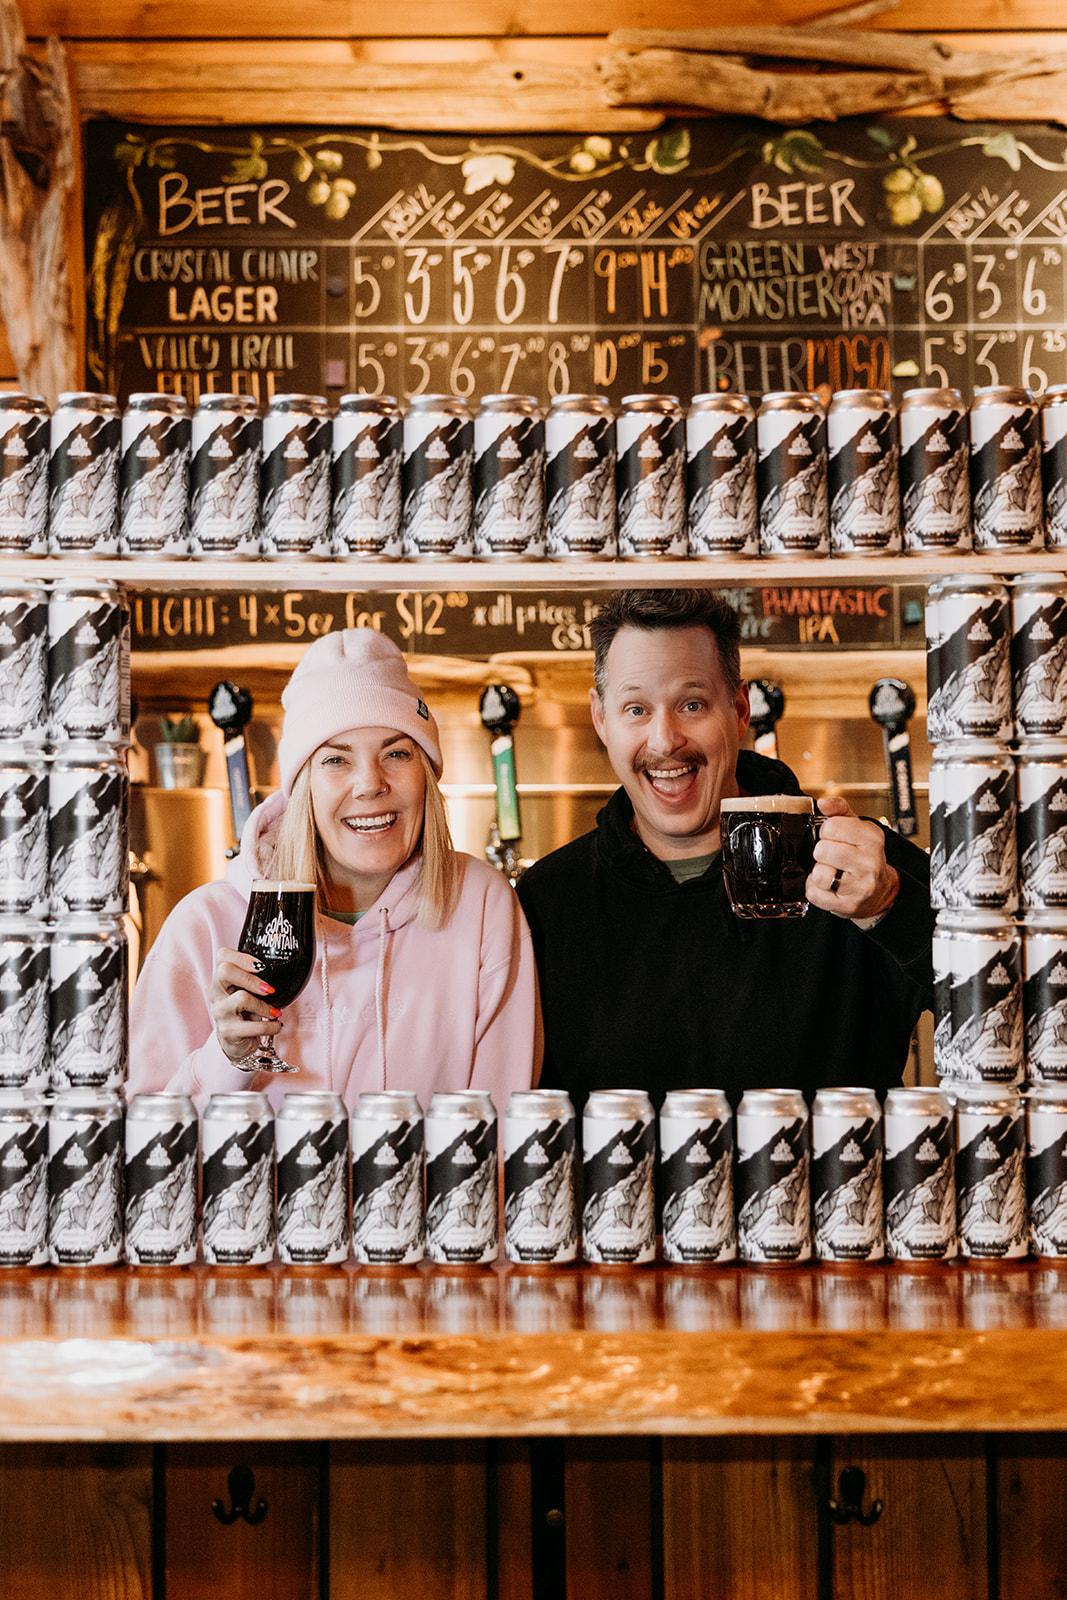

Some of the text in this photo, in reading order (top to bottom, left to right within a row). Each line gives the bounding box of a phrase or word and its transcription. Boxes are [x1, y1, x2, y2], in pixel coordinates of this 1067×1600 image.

[158, 172, 297, 237] BEER
[748, 178, 865, 230] BEER
[134, 249, 232, 283] CRYSTAL
[701, 240, 805, 281] GREEN
[818, 241, 880, 271] WEST
[168, 286, 278, 323] LAGER
[700, 273, 841, 324] MONSTER
[833, 270, 893, 307] COAST
[842, 301, 887, 331] IPA
[131, 597, 230, 637] LIGHT:
[761, 587, 888, 616] PHANTASTIC
[799, 614, 840, 645] IPA
[257, 933, 299, 951] MOUNTAIN
[265, 910, 293, 939] COAST
